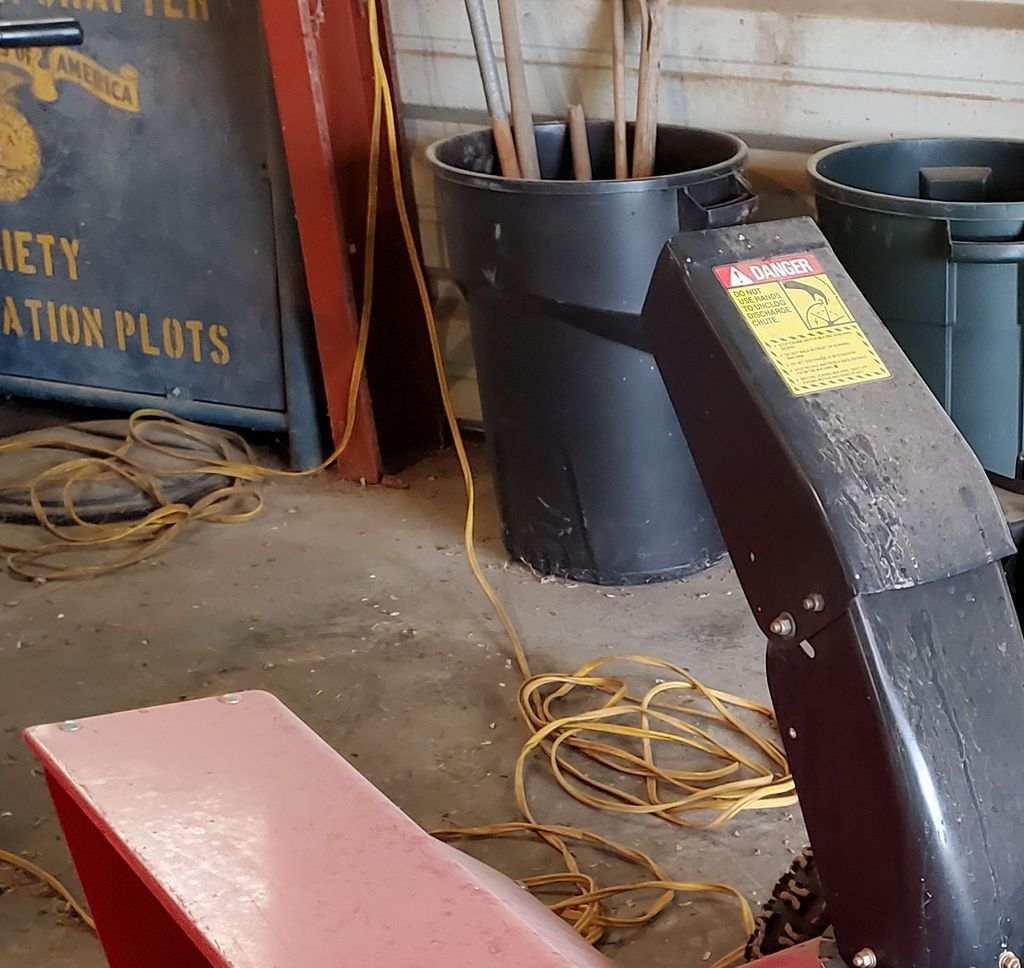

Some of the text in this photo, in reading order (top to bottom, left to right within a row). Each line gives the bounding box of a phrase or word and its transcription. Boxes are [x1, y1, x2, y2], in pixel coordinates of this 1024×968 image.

[56, 54, 133, 105] AMERICA
[0, 229, 79, 281] IETY
[749, 258, 814, 281] DANGER
[733, 288, 762, 298] DO NOT
[737, 292, 782, 305] USE HANDS
[742, 299, 787, 312] TO UNCLOG
[747, 306, 792, 319] DISCHARGE
[115, 309, 230, 365] PLOTS
